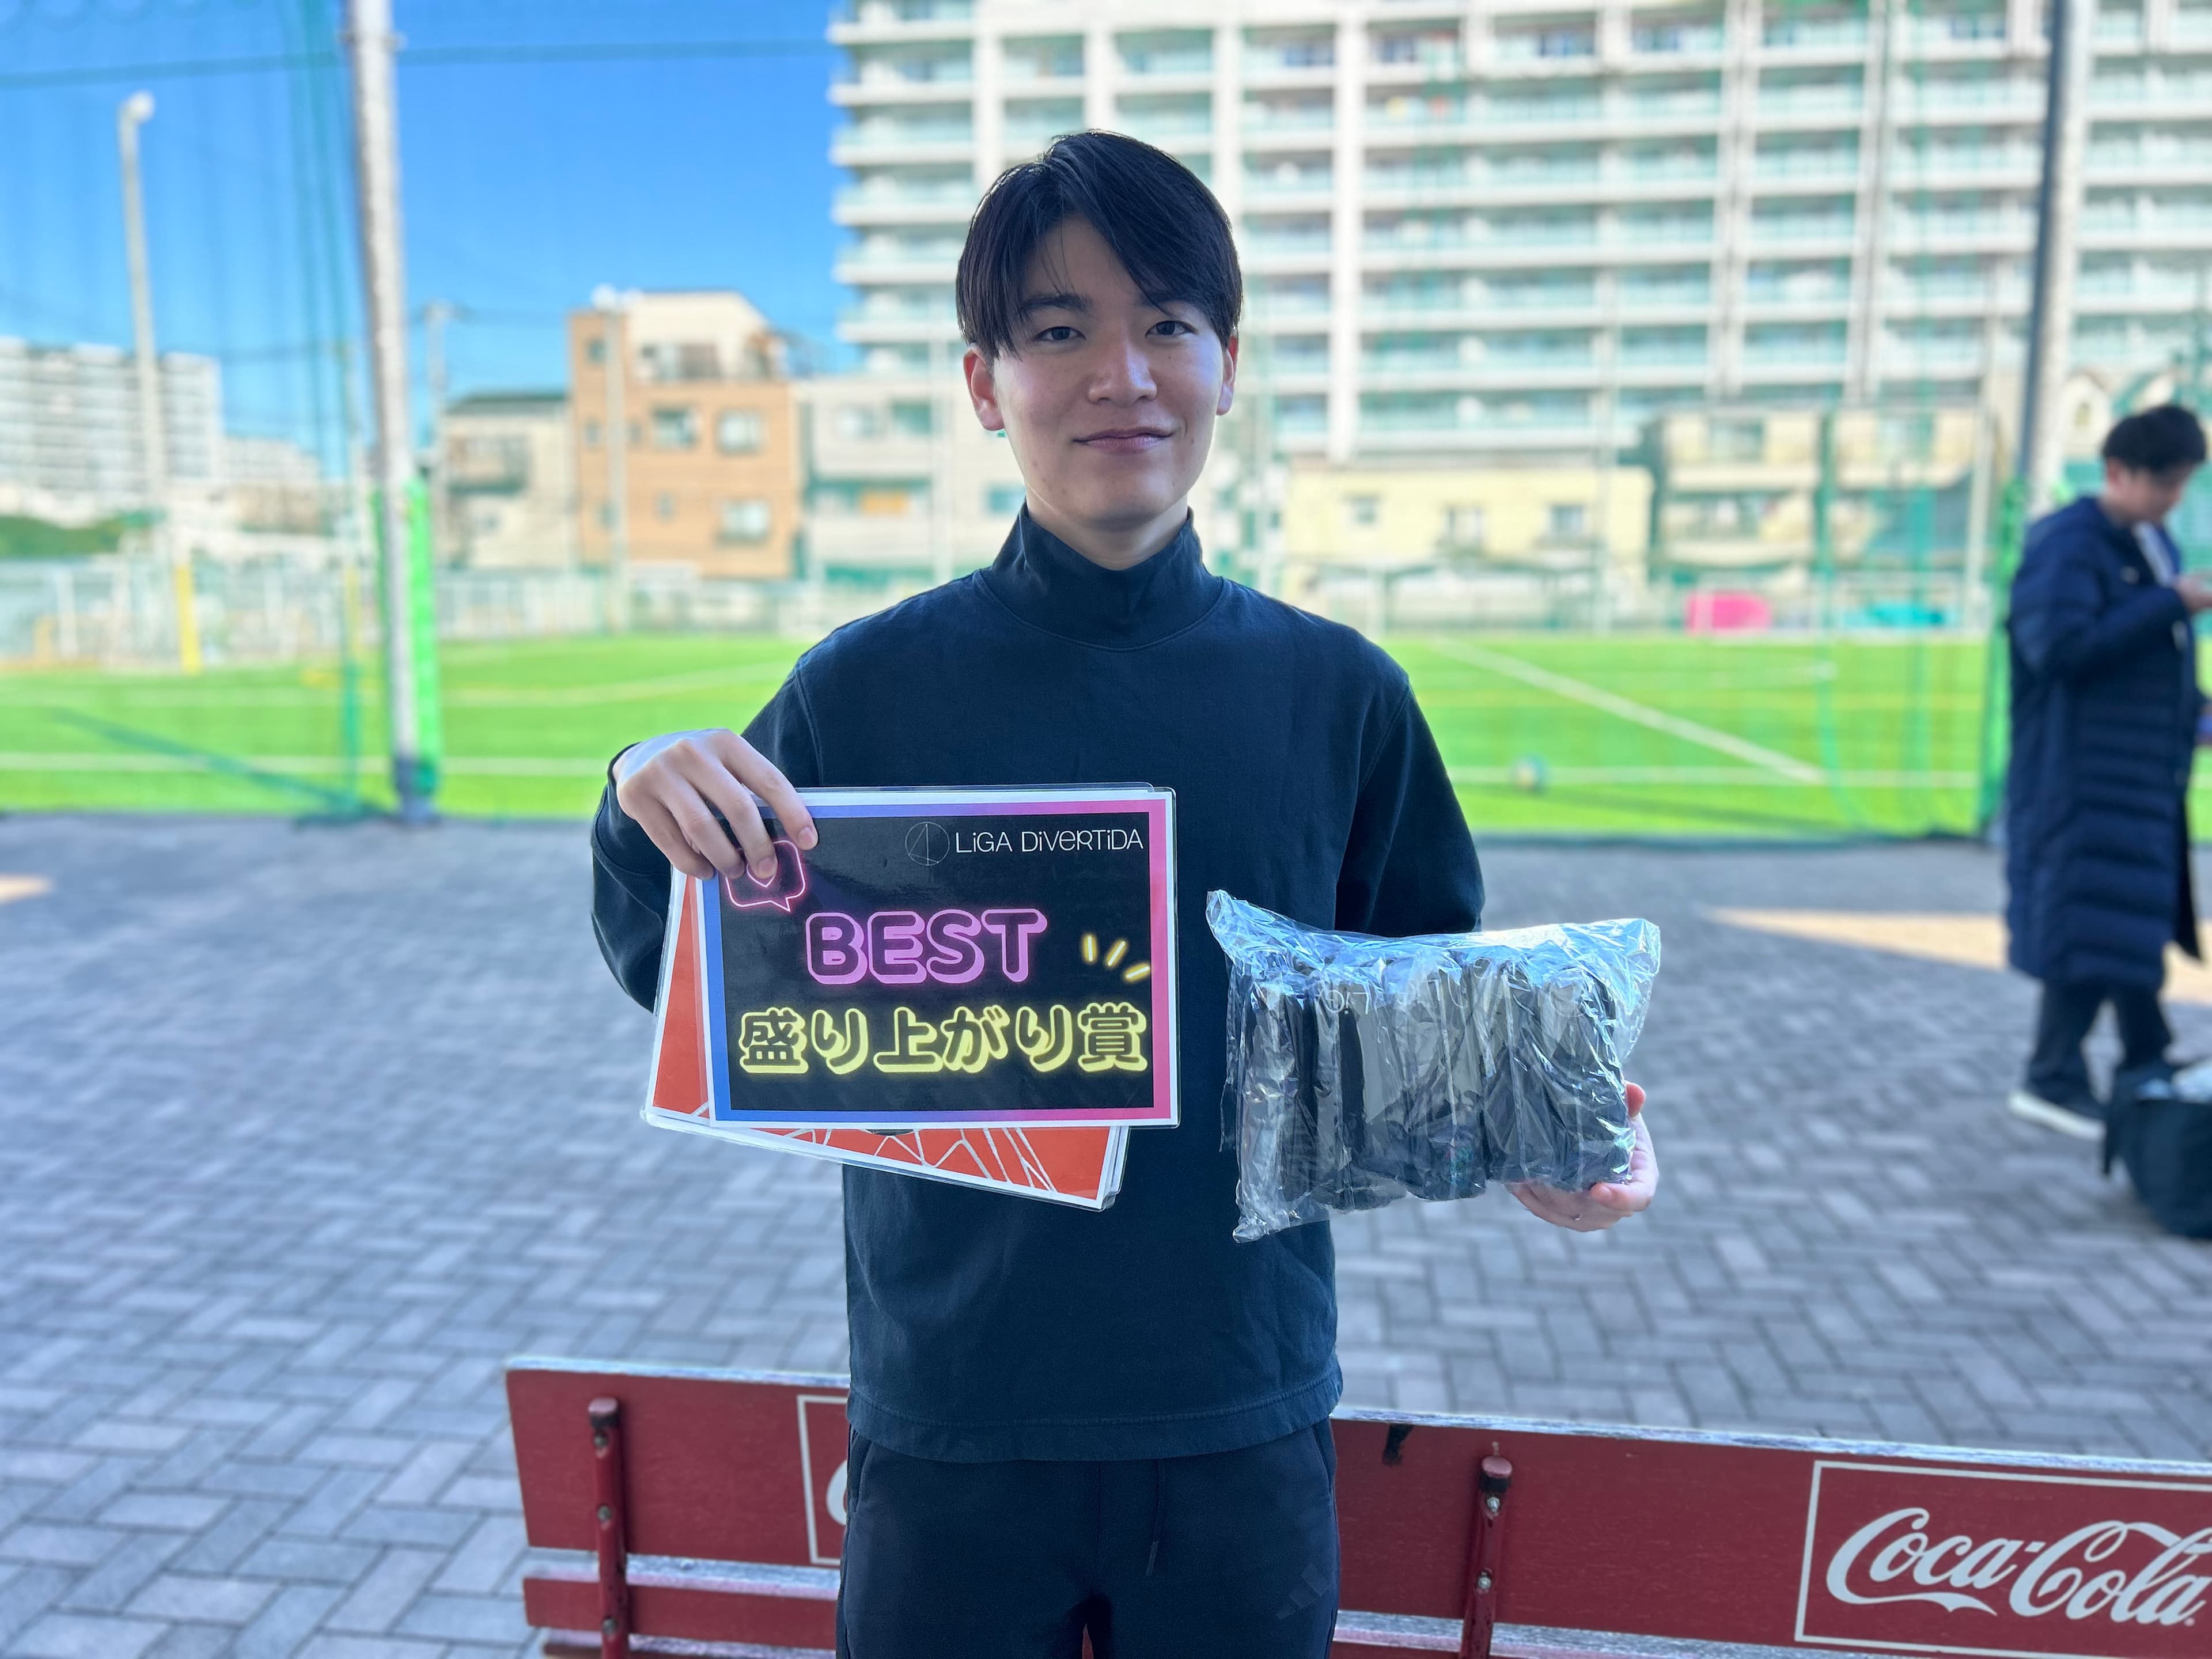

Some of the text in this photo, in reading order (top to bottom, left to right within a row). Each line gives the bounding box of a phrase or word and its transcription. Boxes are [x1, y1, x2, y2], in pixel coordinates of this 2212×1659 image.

[955, 831, 1013, 853] LiGA
[805, 908, 1047, 985] BEST
[738, 1002, 1148, 1074] 盛り上がり賞
[1826, 1507, 2212, 1626] Coca-Cola
